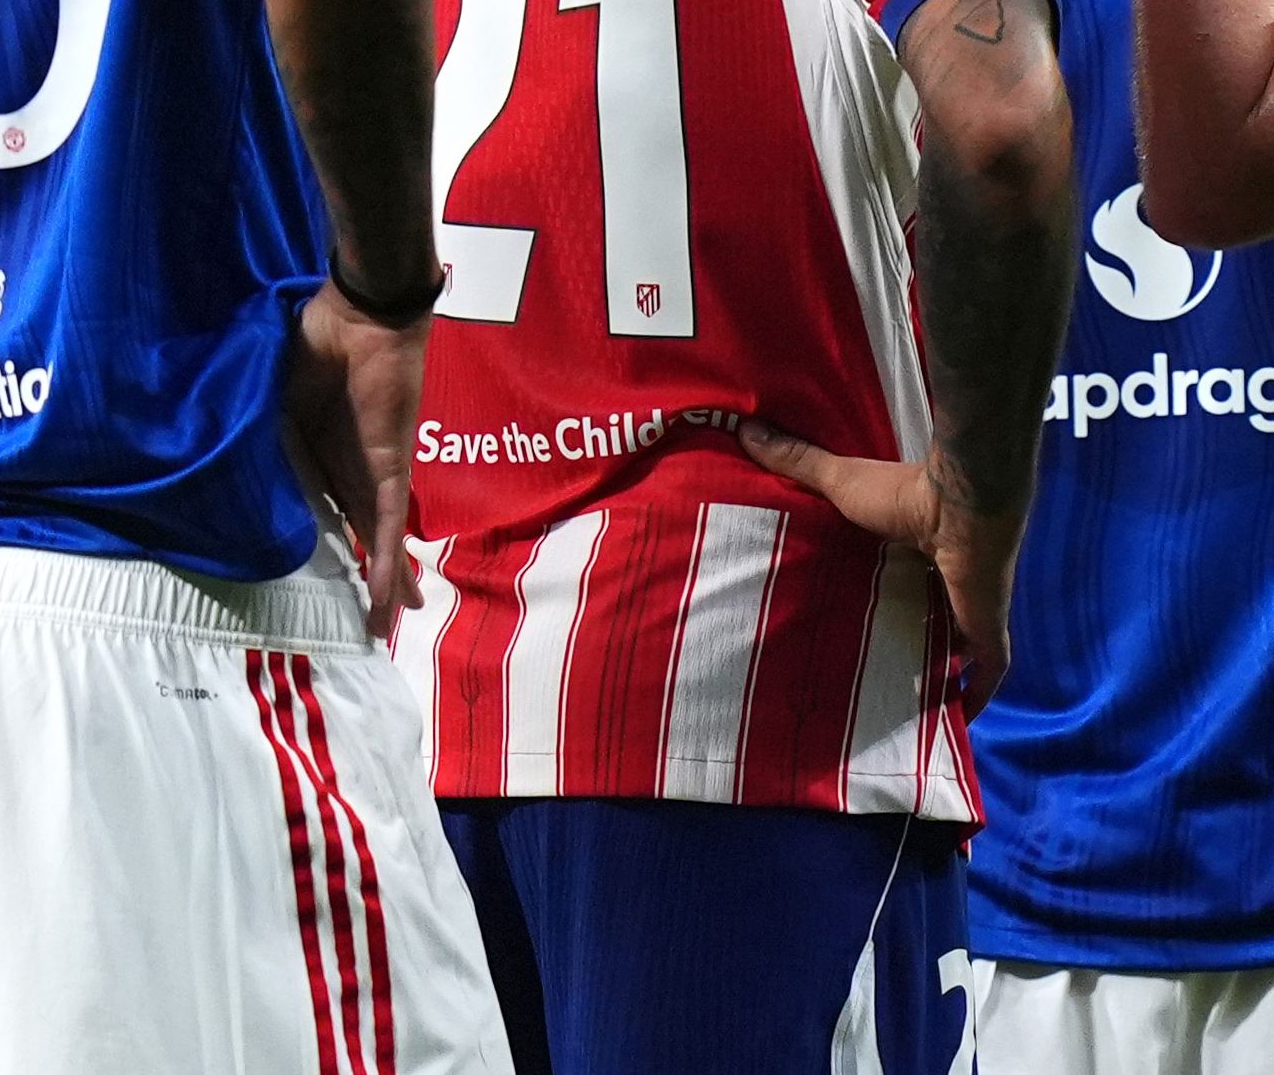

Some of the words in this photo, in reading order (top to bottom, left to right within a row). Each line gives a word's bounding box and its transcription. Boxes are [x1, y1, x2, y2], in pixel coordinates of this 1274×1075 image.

[415, 420, 499, 464] Save
[502, 422, 551, 463] the
[555, 408, 739, 461] Childen
